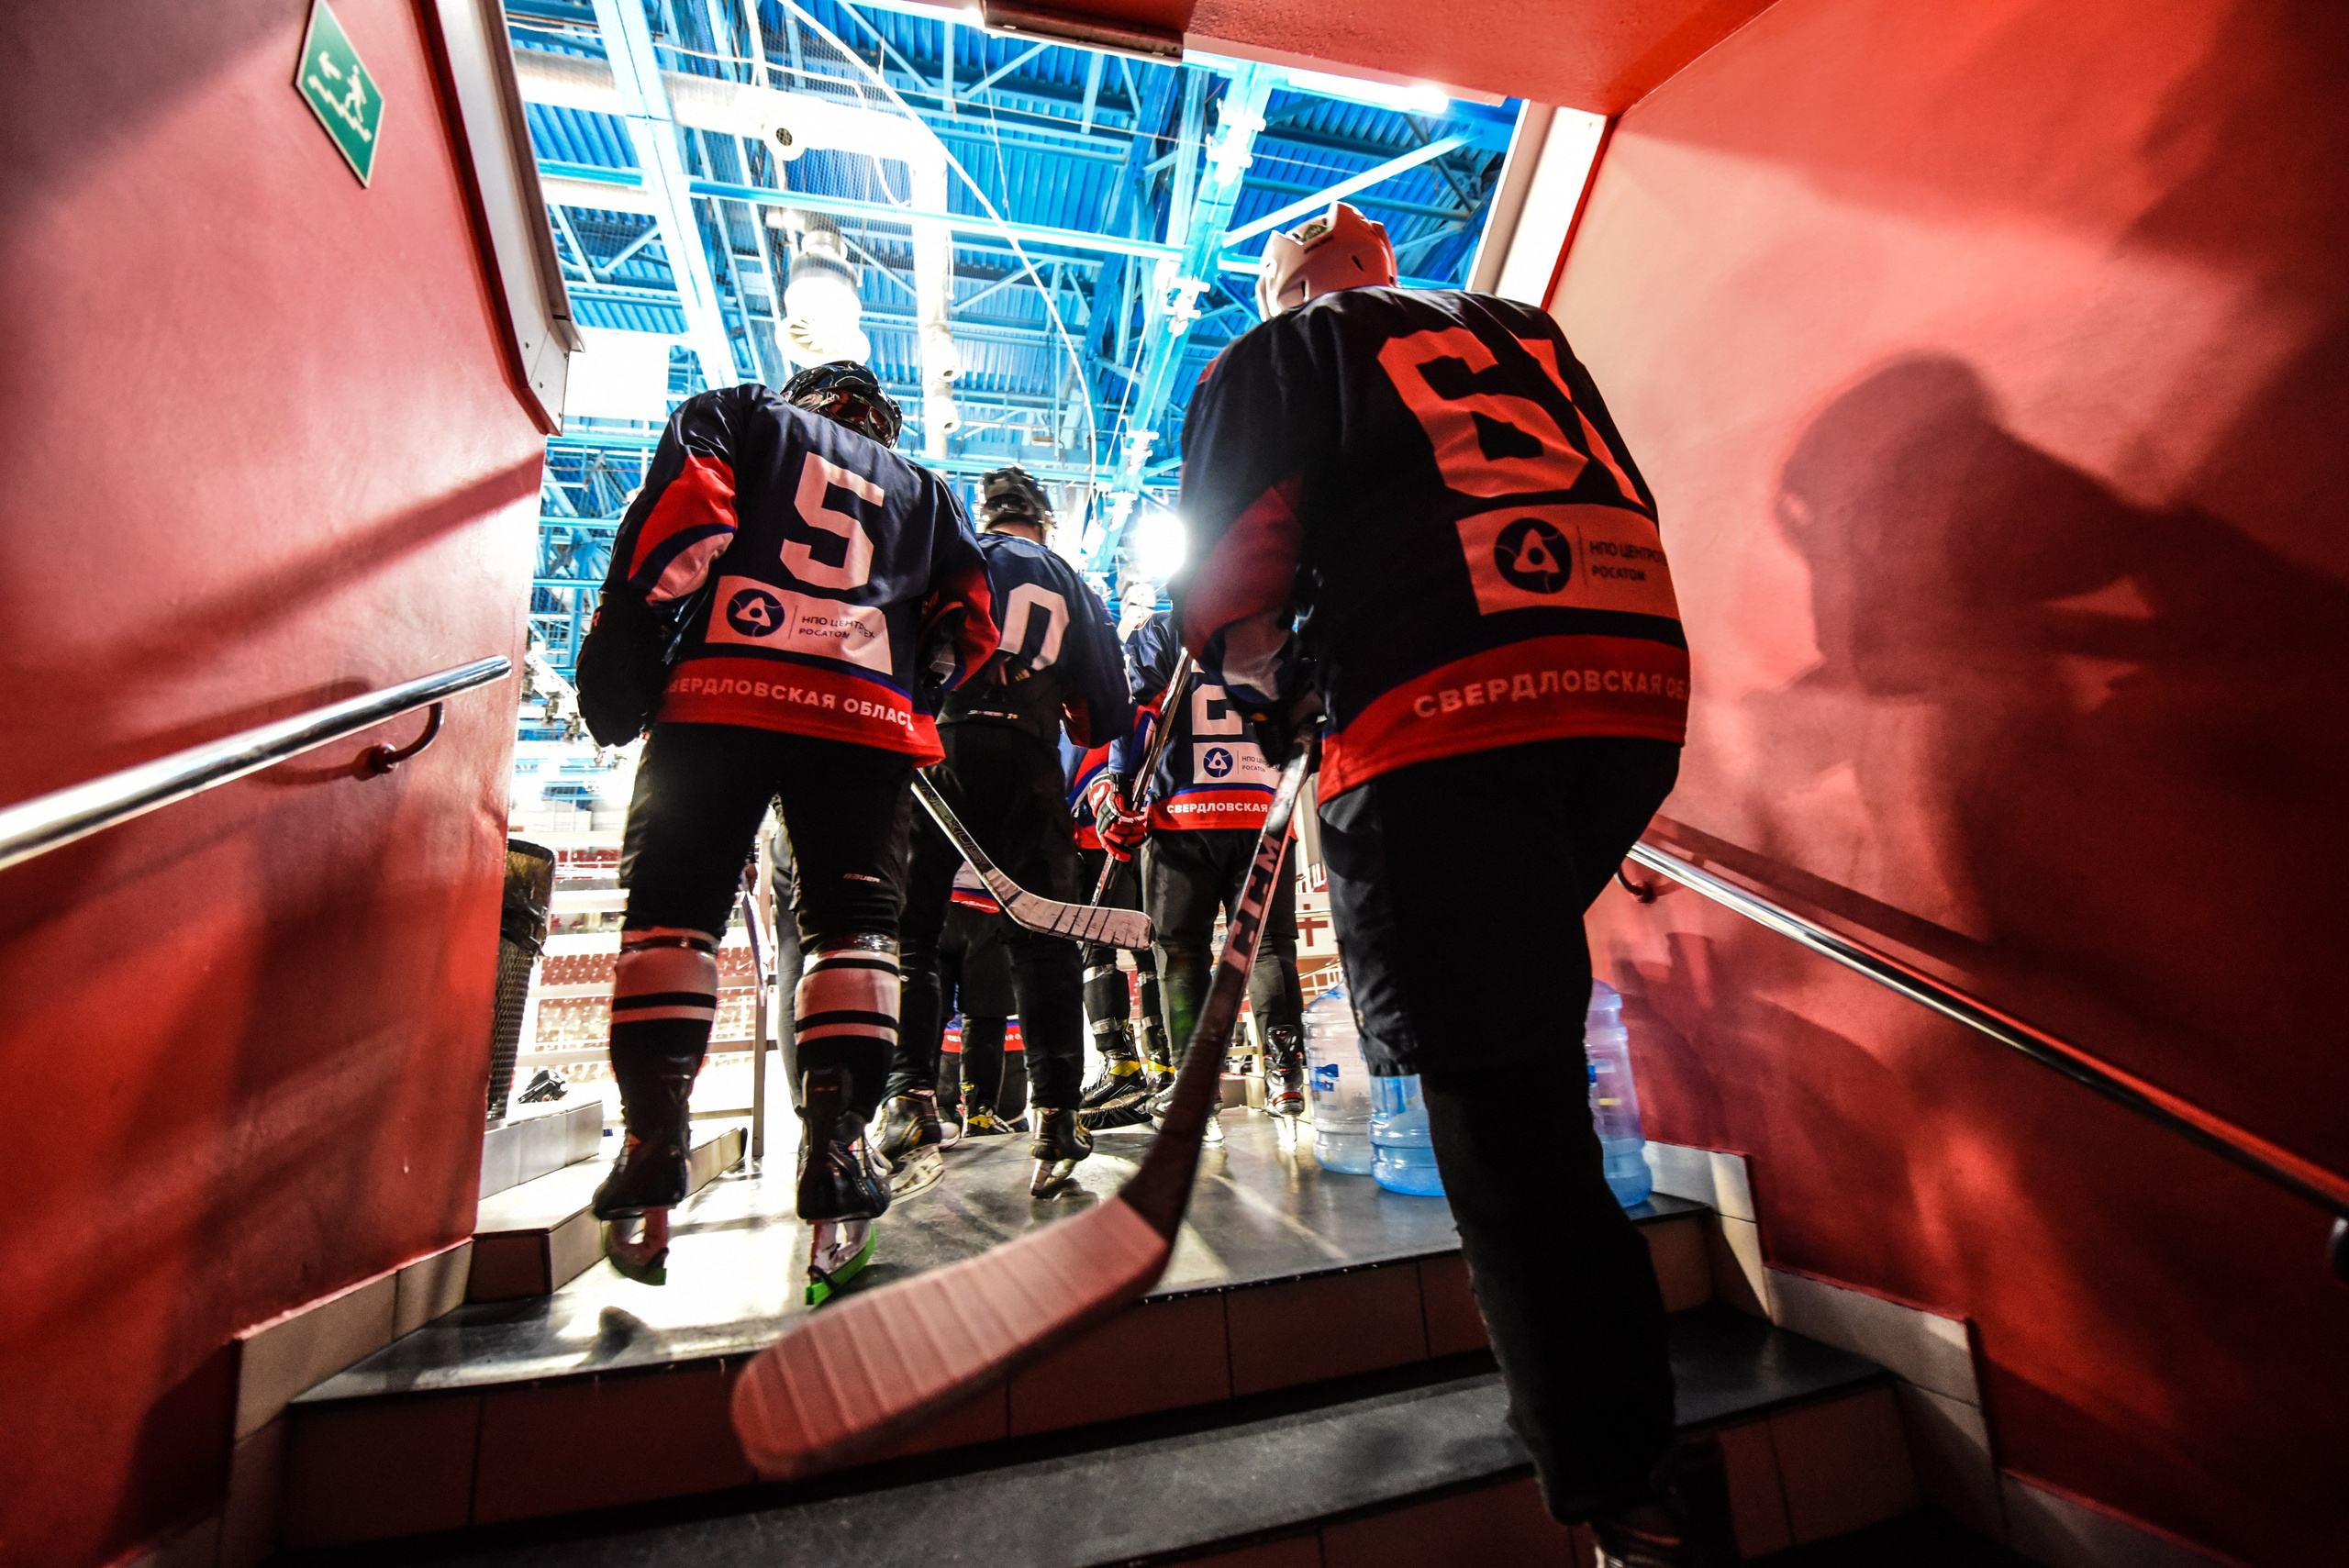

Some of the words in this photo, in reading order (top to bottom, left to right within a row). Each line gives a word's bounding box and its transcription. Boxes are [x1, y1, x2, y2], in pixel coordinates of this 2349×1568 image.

[1376, 326, 1650, 510] 61
[780, 450, 885, 592] 5
[1589, 540, 1617, 557] НПО
[1592, 565, 1645, 581] РОСАТОМ
[802, 616, 828, 625] НПО
[668, 678, 835, 709] ВЕРДЛОВСКАЯ
[1413, 670, 1662, 717] СВЕРДЛОВСКАЯ
[1166, 802, 1268, 814] СВЕРДЛОВСКАЯ
[1222, 832, 1283, 974] CCM
